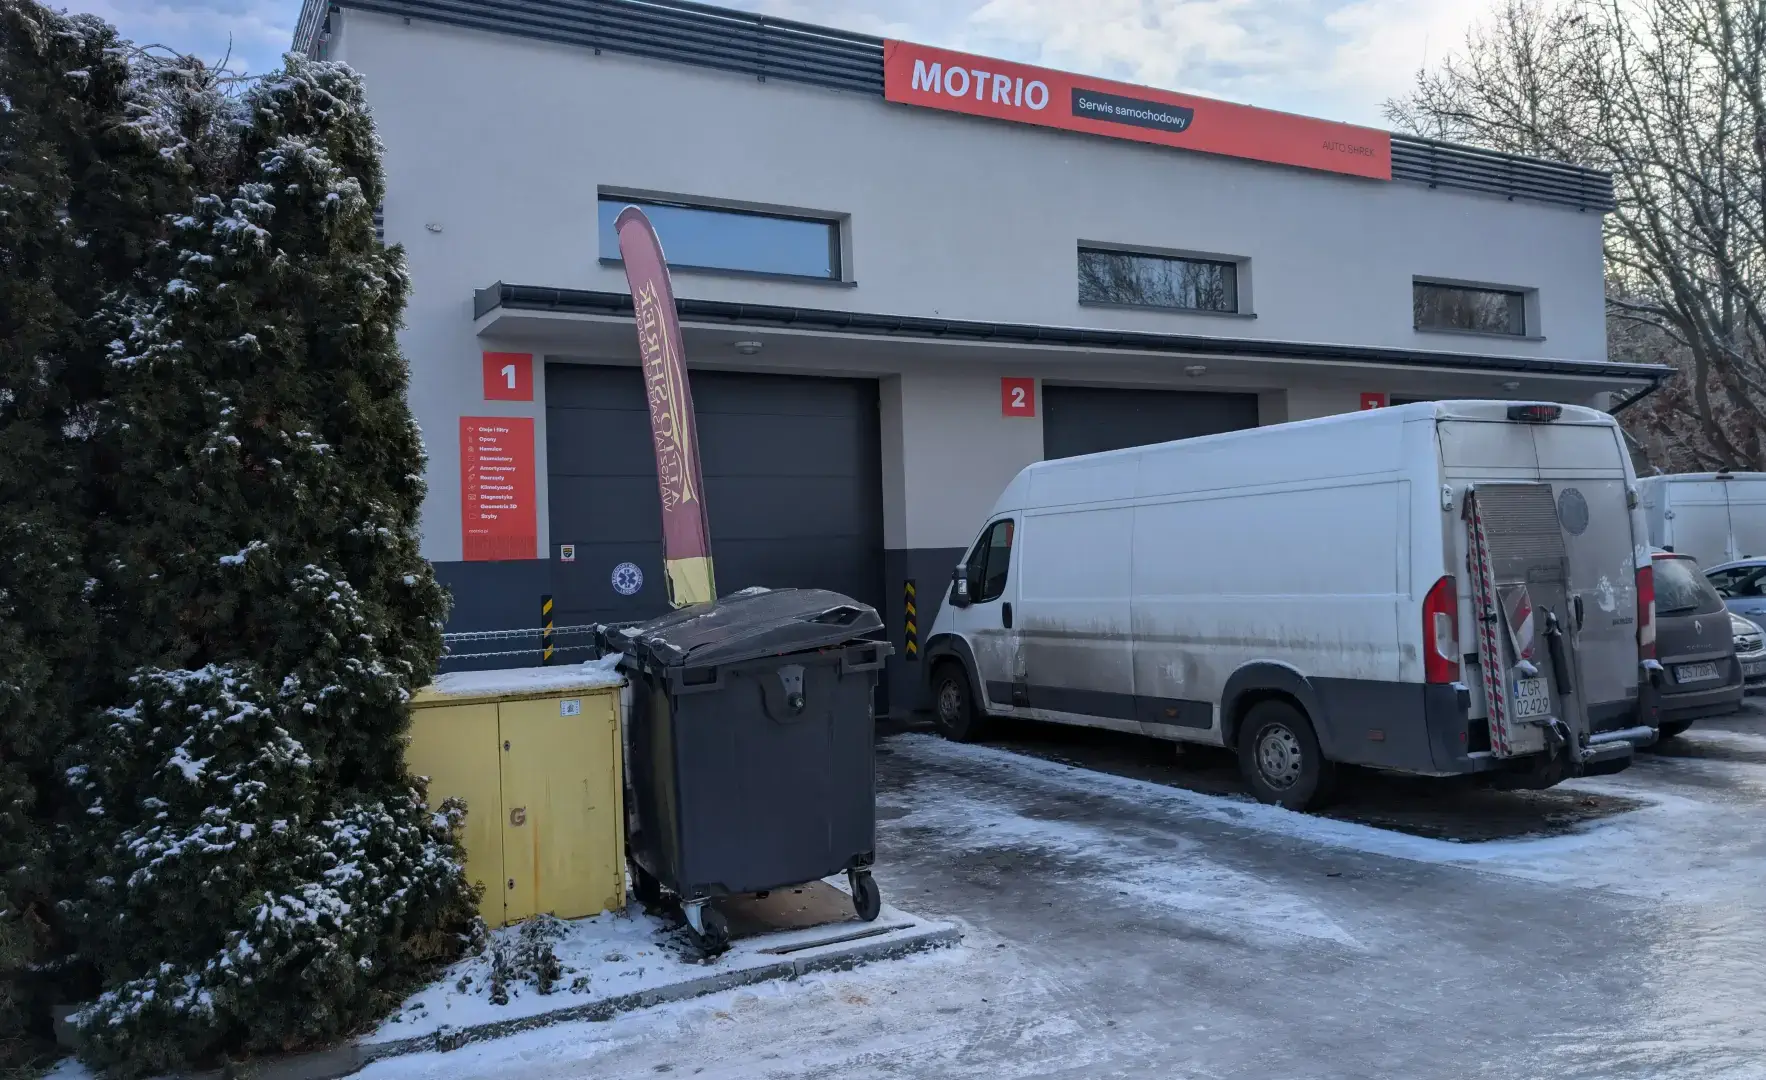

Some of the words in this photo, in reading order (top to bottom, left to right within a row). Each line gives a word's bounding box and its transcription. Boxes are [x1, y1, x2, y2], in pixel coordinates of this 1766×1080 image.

[911, 59, 1049, 110] MOTRIO
[1078, 97, 1114, 115] Serwis
[1115, 106, 1186, 128] samochodowy
[1322, 140, 1346, 153] AUTO
[1347, 144, 1376, 157] SHREK
[501, 364, 515, 389] 1
[1011, 386, 1026, 408] 2
[1519, 679, 1541, 697] ZGR
[1516, 697, 1549, 716] 02429
[509, 805, 527, 827] G
